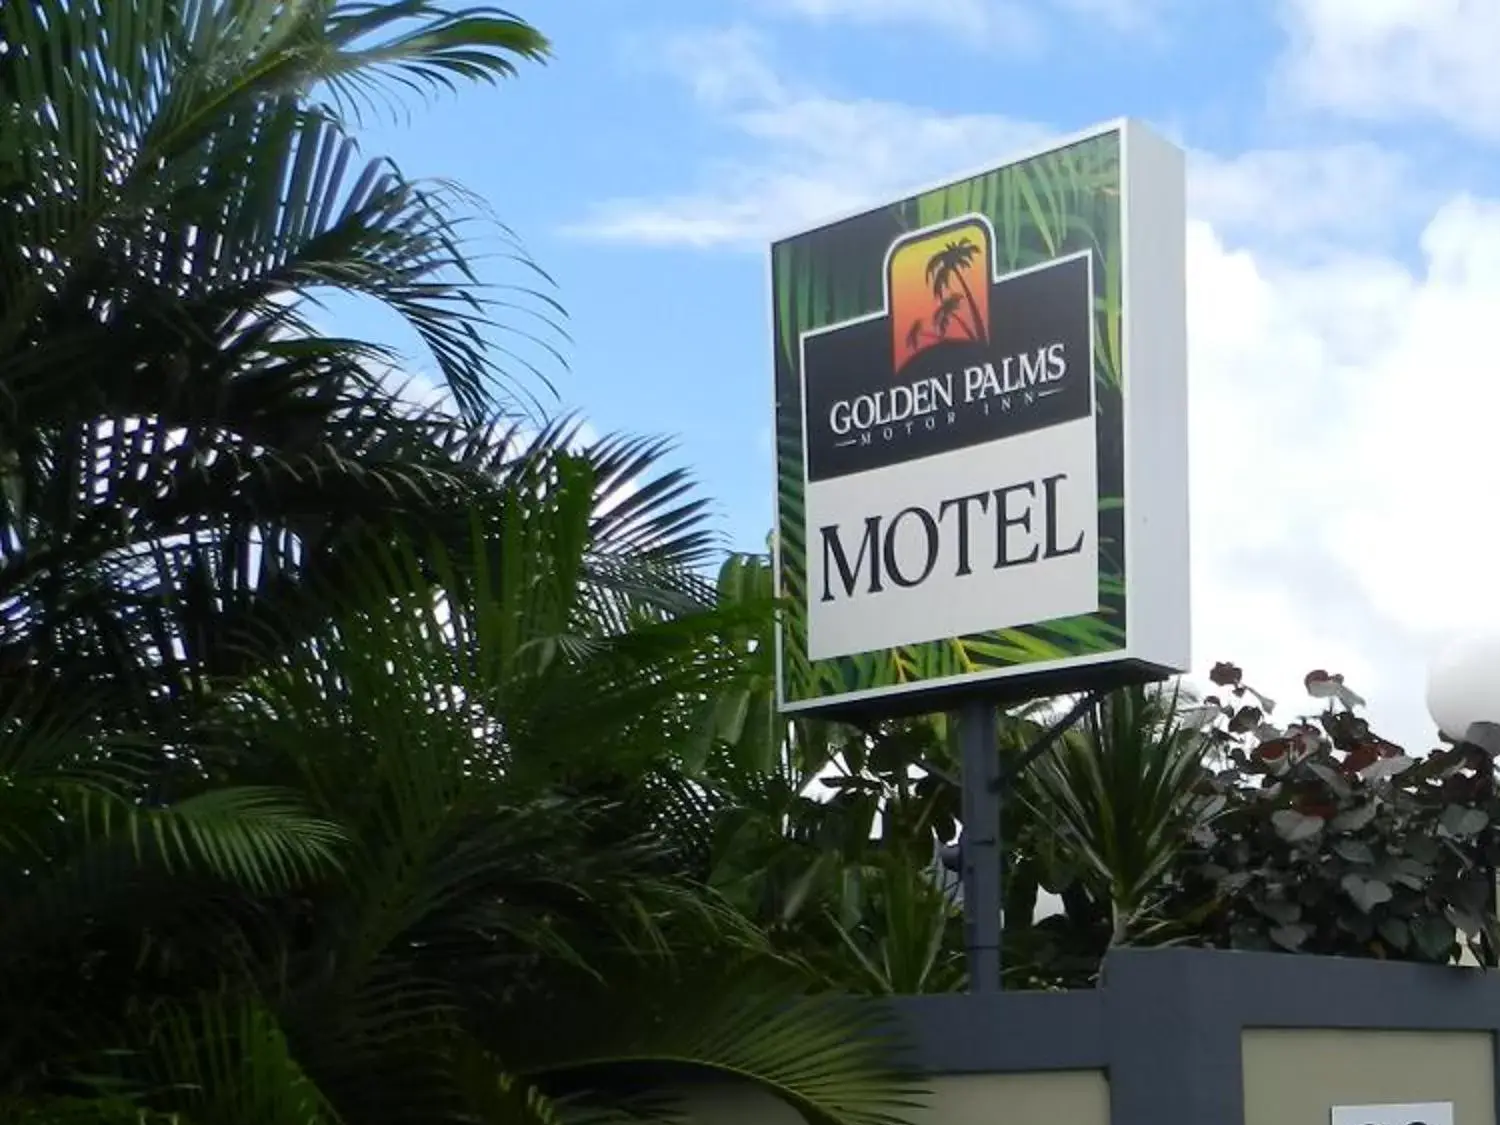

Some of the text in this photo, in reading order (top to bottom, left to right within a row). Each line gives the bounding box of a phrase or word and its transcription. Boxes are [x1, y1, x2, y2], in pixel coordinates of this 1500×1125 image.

[829, 343, 1067, 435] GOLDEN PALMS
[860, 391, 1034, 447] MOTOR INN
[820, 472, 1086, 603] MOTEL
